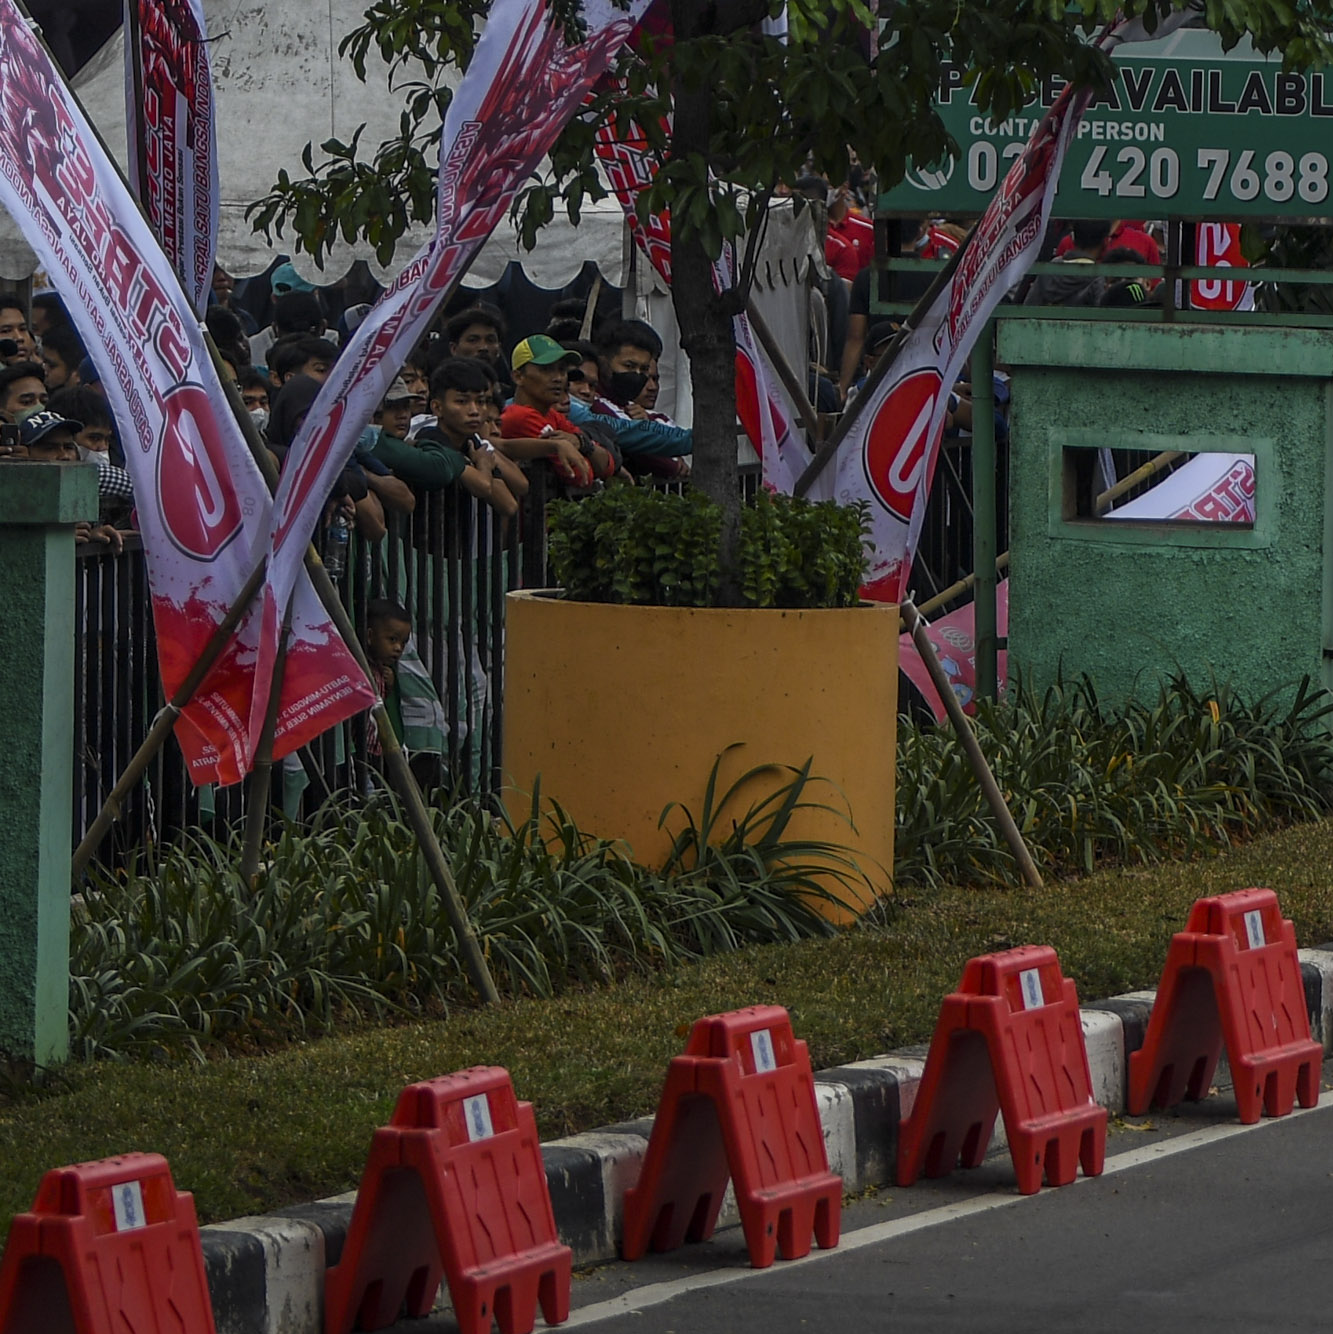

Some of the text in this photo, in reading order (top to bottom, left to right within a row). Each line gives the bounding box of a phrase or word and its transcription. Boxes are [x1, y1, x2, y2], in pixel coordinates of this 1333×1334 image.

[195, 44, 210, 118] INDONE
[163, 116, 174, 162] JAYA
[193, 117, 211, 188] BANGSA
[970, 116, 1165, 142] CONTA PERSON
[163, 168, 175, 230] METRO
[968, 141, 1330, 205] 02 420 7688
[193, 187, 211, 237] SATU
[997, 215, 1042, 275] BANGSA
